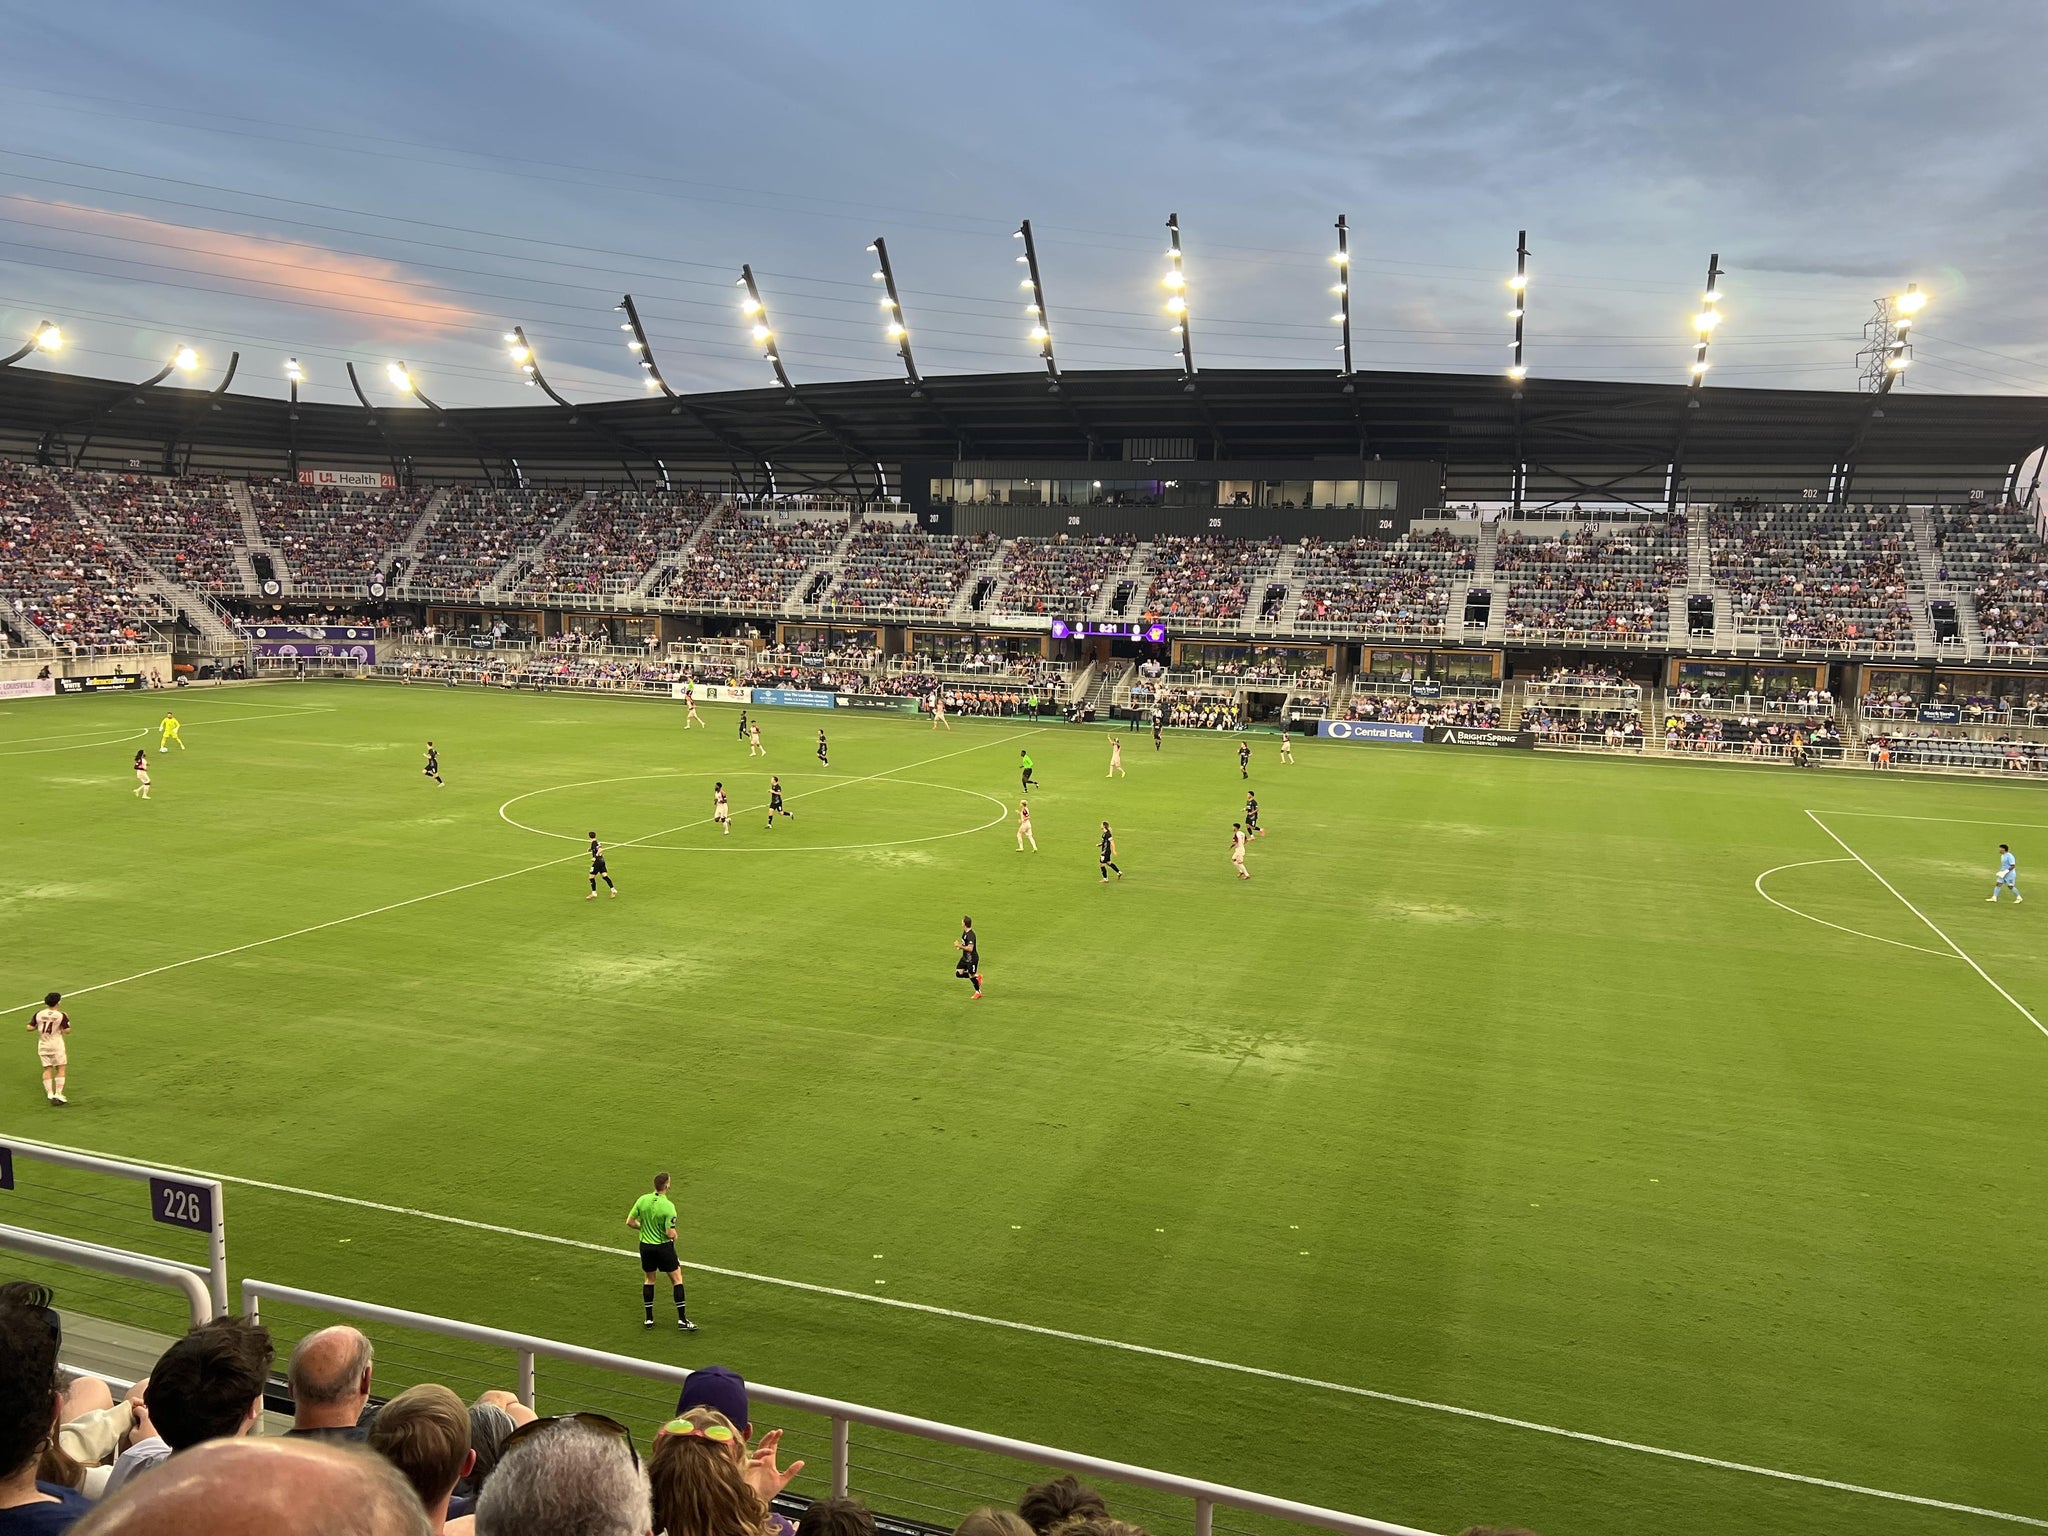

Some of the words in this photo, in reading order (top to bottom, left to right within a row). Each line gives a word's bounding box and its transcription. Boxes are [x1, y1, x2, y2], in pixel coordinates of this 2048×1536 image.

[129, 459, 140, 467] 212
[299, 471, 313, 483] 211
[340, 474, 376, 485] Health
[382, 475, 396, 486] 211
[1803, 489, 1818, 498] 202
[1970, 490, 1984, 499] 201
[930, 514, 939, 522] 207
[1068, 516, 1080, 525] 206
[1209, 518, 1221, 527] 205
[1379, 519, 1392, 529] 204
[1585, 522, 1598, 532] 203
[1075, 622, 1084, 633] 0
[1132, 624, 1141, 635] 0
[3, 682, 34, 690] LOUISVILLE
[1354, 727, 1388, 737] Central
[1389, 729, 1413, 739] Bank
[42, 1021, 54, 1035] 14
[163, 1188, 200, 1223] 226
